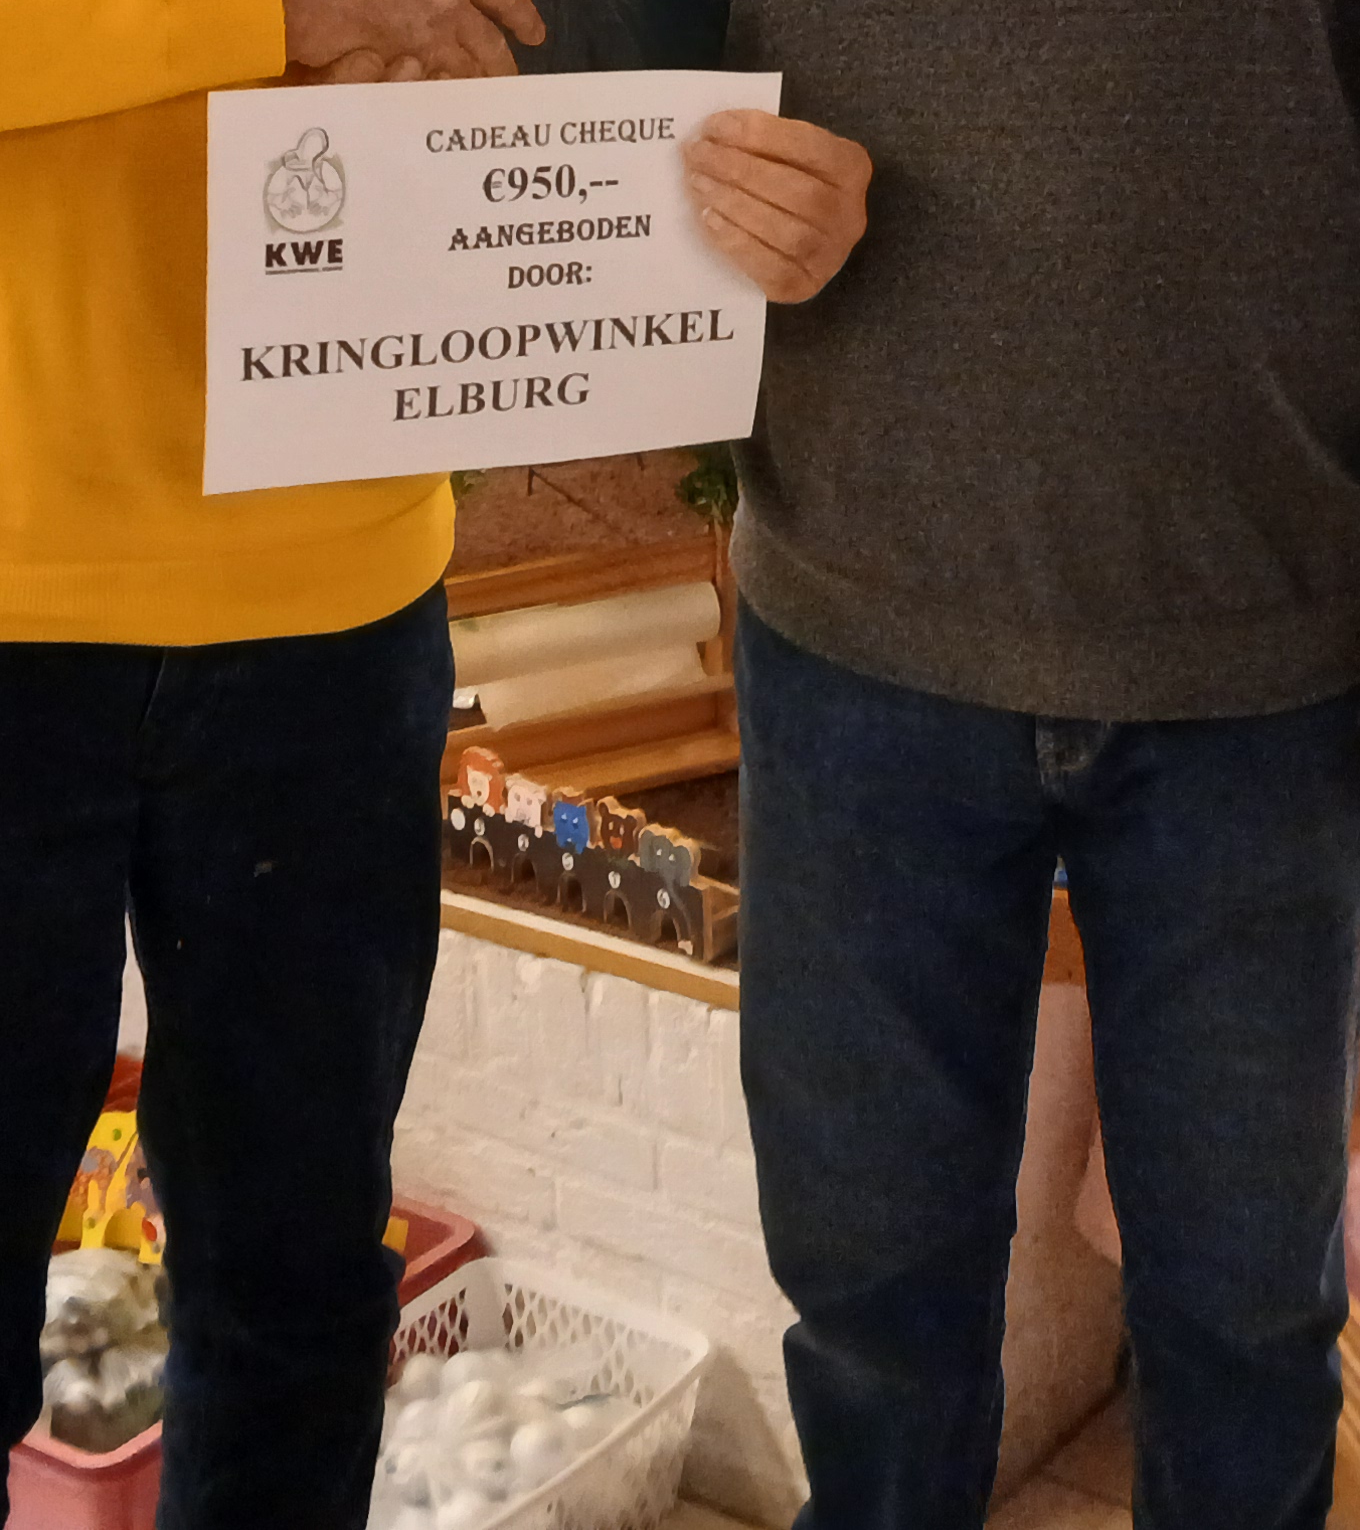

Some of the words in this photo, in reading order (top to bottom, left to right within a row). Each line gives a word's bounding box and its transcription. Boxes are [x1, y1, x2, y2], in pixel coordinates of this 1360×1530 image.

[426, 123, 551, 153] CADEAU
[559, 117, 675, 145] CHEQUE
[482, 164, 619, 204] €950,--
[448, 214, 651, 251] AANGEBODEN
[265, 239, 343, 268] KWE
[507, 261, 592, 289] DOOR:
[241, 308, 735, 381] KRINGLOOPWINKEL
[392, 372, 591, 422] ELBURG
